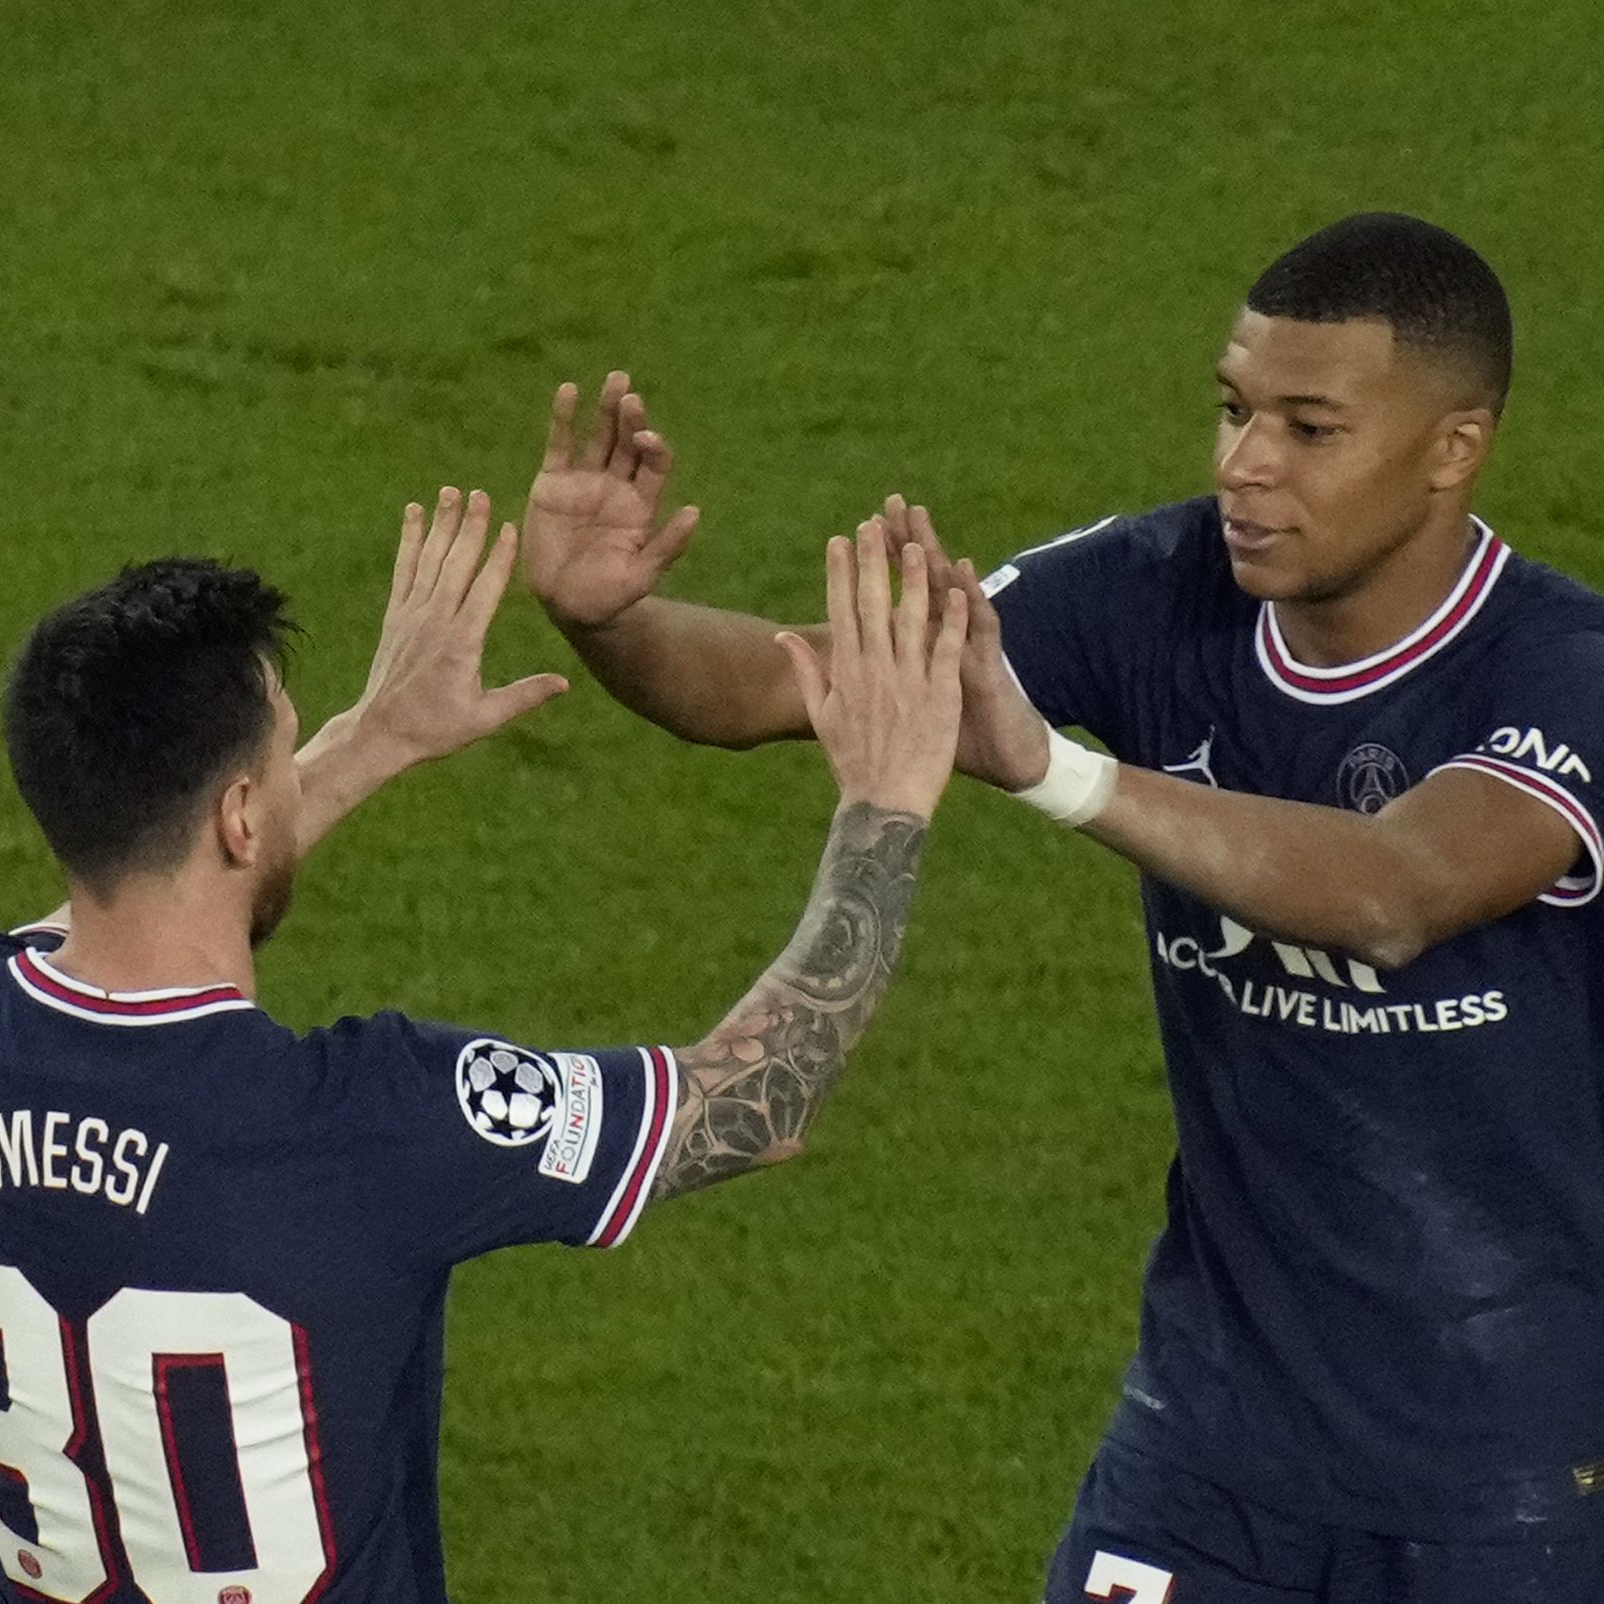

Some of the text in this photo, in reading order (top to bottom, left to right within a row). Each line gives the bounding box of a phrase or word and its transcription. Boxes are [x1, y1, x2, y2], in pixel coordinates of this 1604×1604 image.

[1241, 981, 1508, 1034] LIVE LIMITLESS
[555, 1056, 586, 1175] FOUNDATIO
